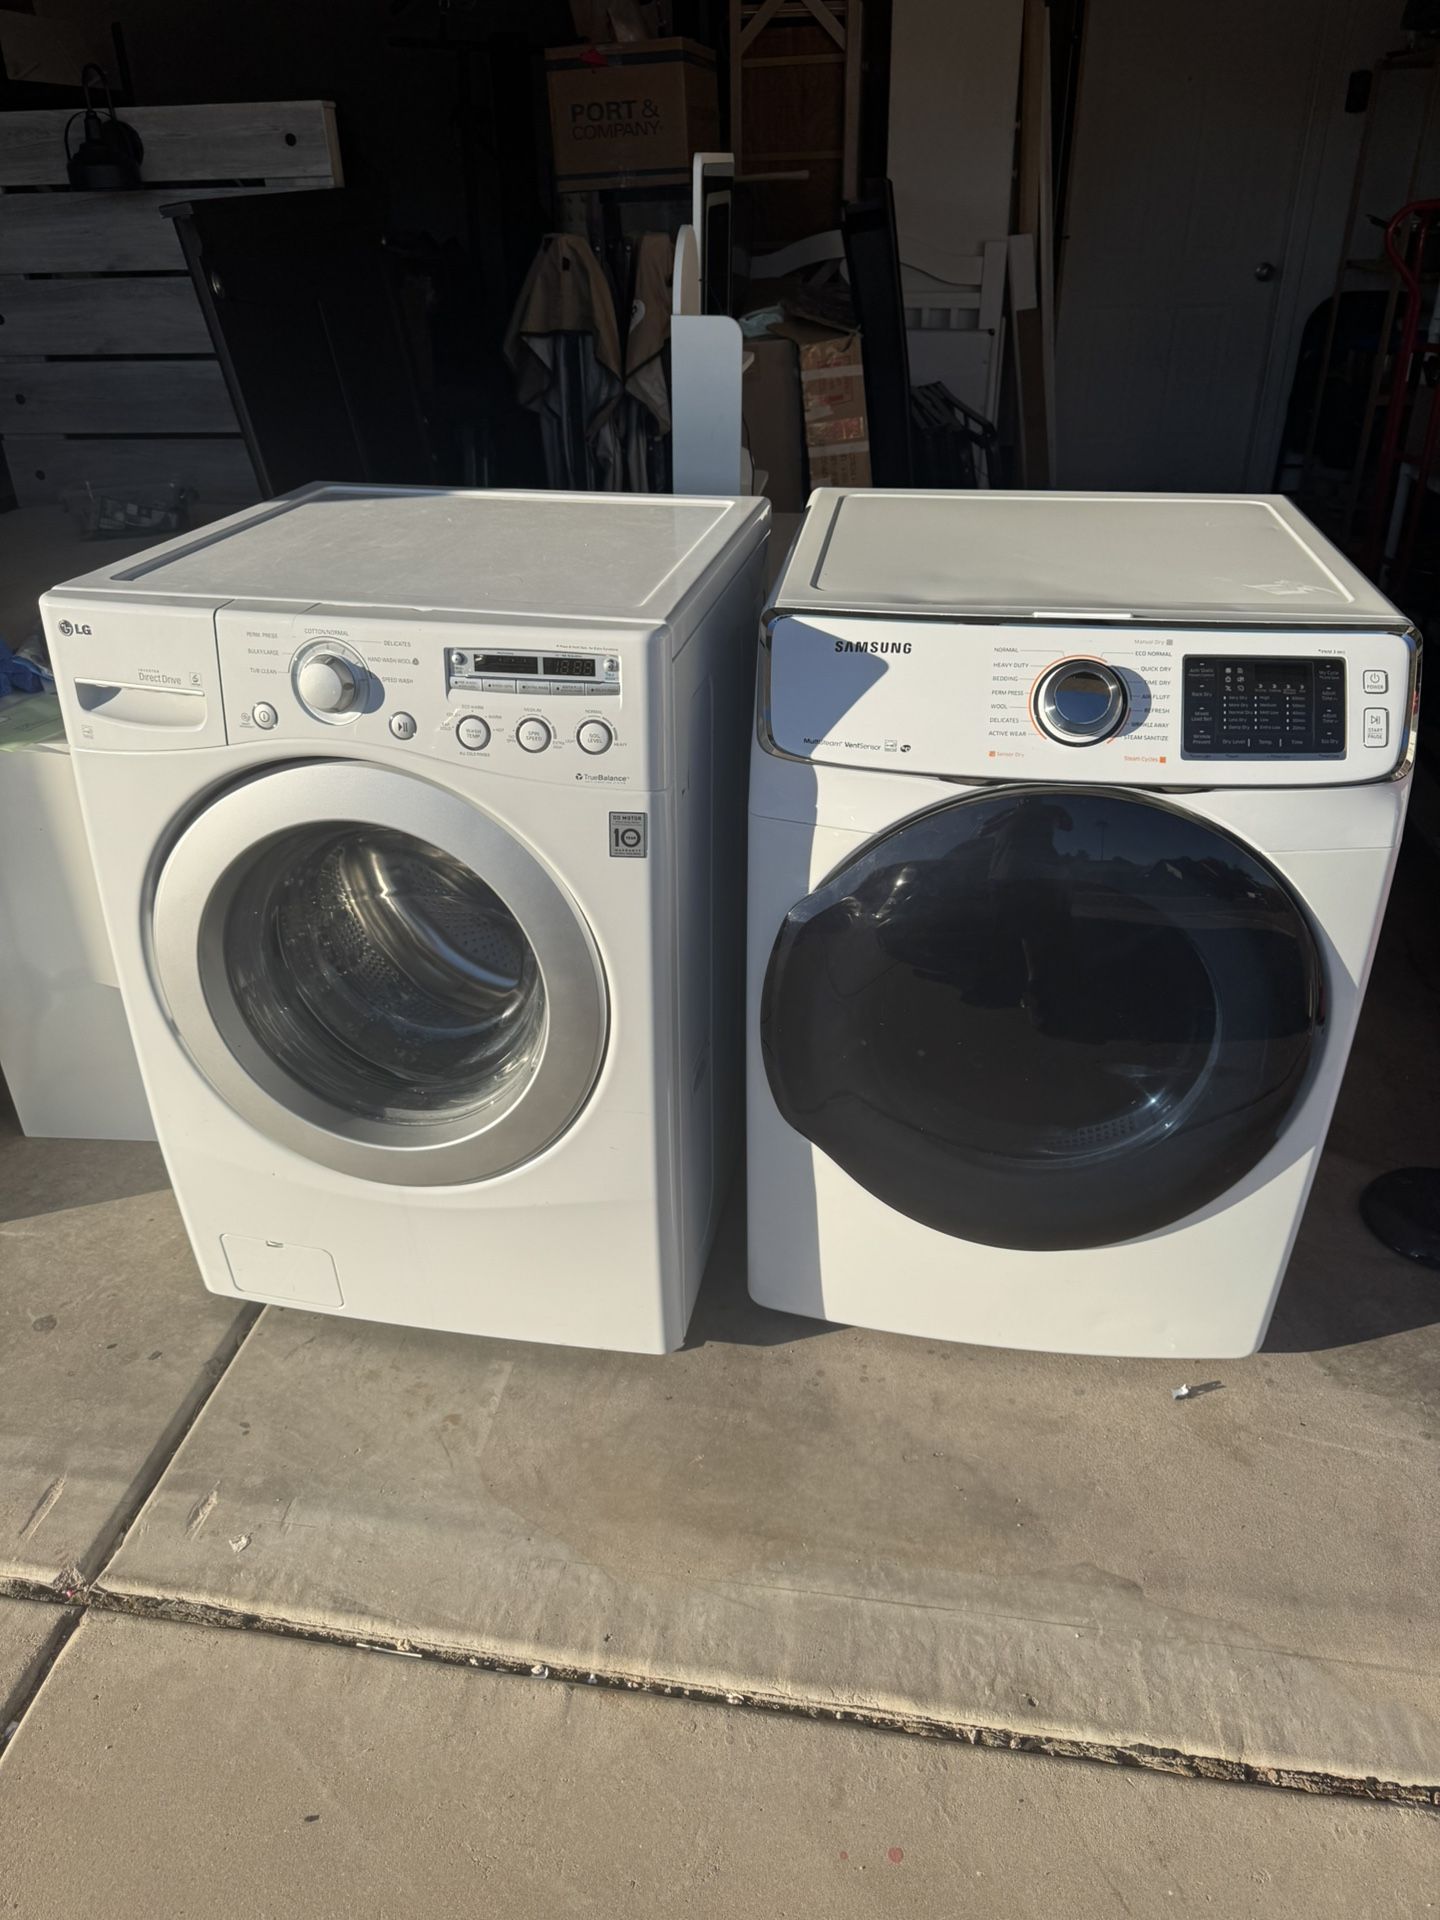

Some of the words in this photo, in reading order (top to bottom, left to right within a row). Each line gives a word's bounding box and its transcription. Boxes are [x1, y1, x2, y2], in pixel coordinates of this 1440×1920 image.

[571, 100, 637, 122] PORT
[641, 98, 660, 118] &
[572, 120, 661, 141] COMPANY
[75, 623, 92, 636] LG
[383, 640, 411, 648] DELICATES
[834, 641, 912, 654] SAMSUNG
[139, 672, 161, 683] Direct
[162, 676, 182, 685] Drive
[381, 676, 397, 684] SPEED
[844, 742, 881, 751] VentSensor
[1014, 751, 1025, 759] Dry
[584, 773, 627, 781] TrueBalance
[614, 828, 642, 848] 10
